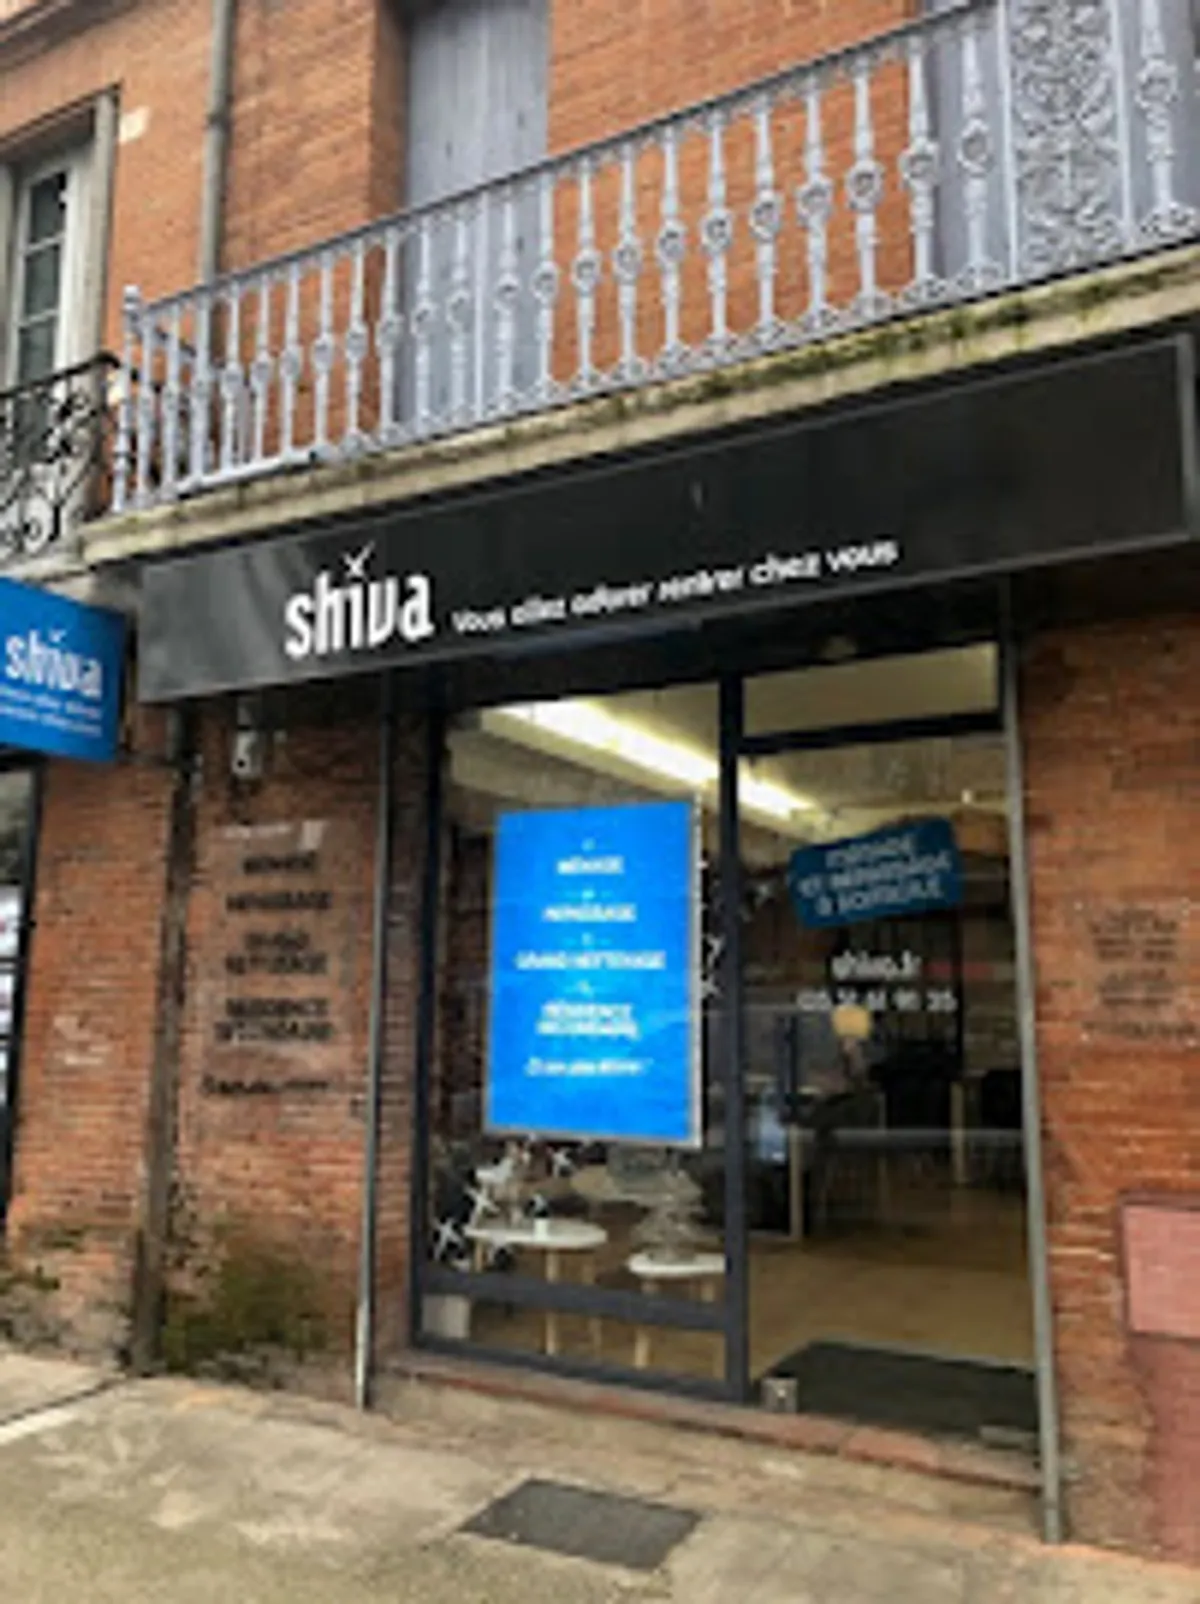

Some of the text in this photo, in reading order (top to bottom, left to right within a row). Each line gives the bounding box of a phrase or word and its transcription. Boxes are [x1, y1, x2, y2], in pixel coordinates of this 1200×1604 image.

[285, 541, 435, 661] shiva
[750, 552, 821, 585] chez
[825, 540, 899, 572] vous
[5, 629, 103, 698] shiva
